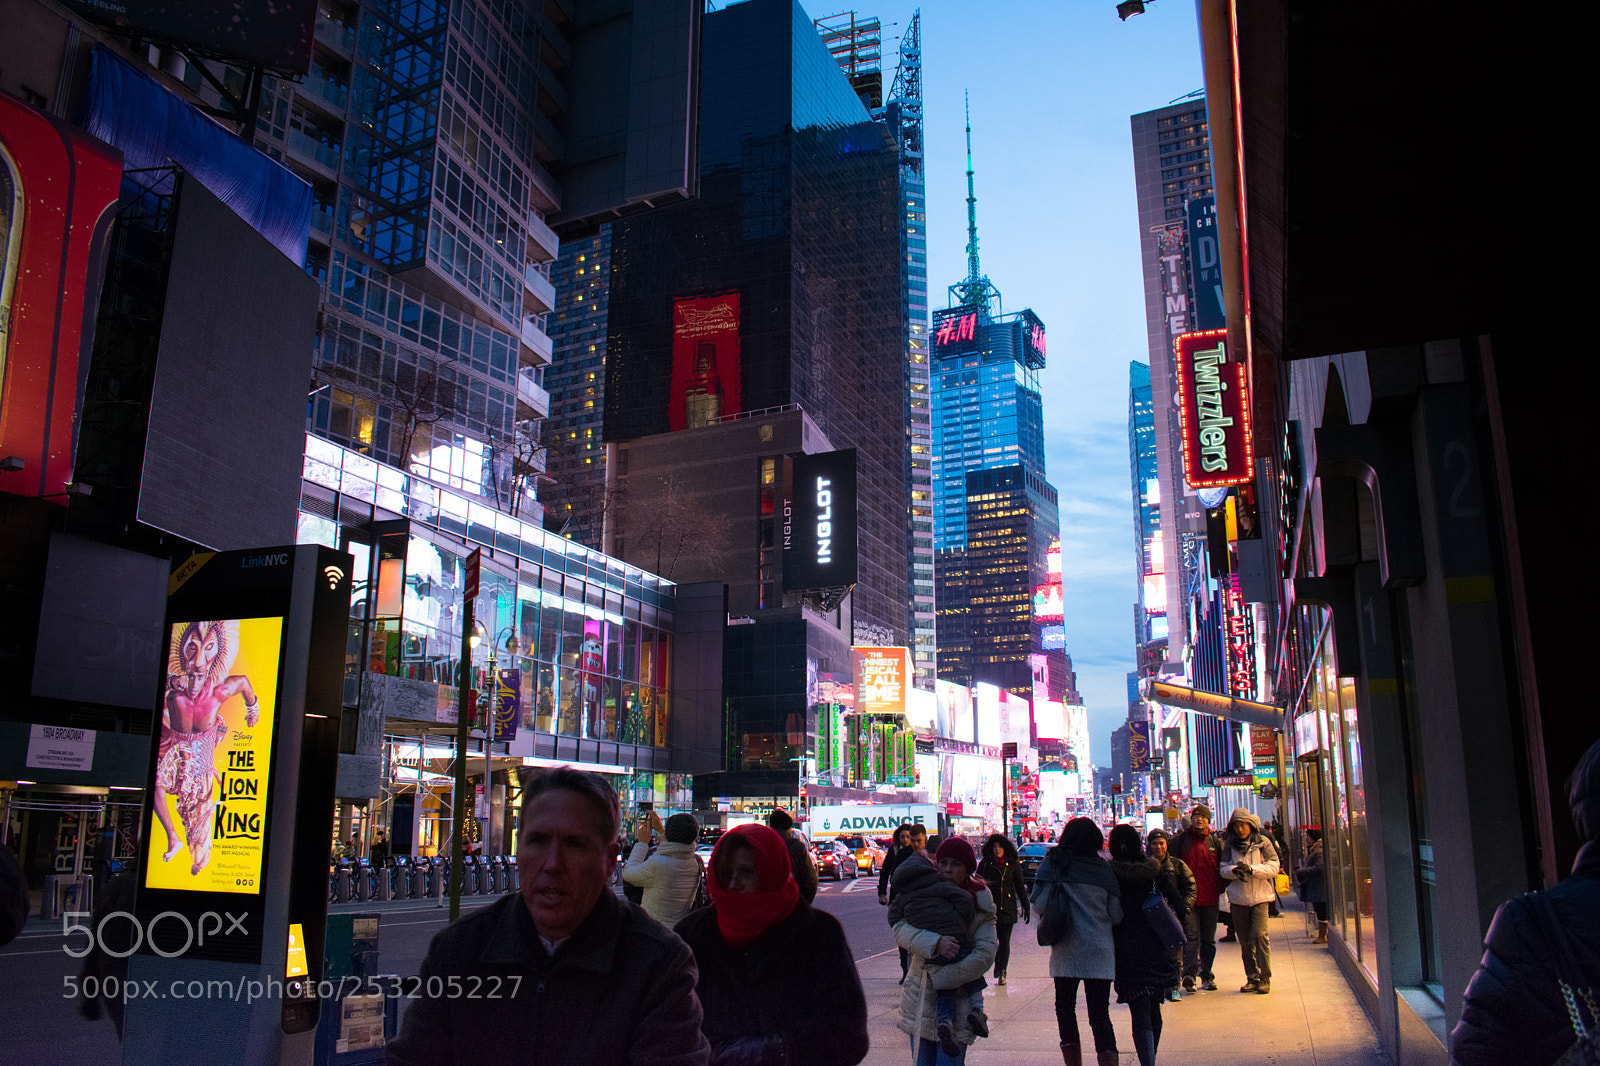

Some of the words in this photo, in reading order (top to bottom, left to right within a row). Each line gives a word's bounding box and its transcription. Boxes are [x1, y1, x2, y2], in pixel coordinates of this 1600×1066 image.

[936, 313, 977, 346] H&M
[1191, 340, 1233, 474] Twizzlers
[1442, 440, 1481, 519] 2
[783, 499, 792, 550] INGLOT
[816, 476, 832, 564] INGLOT
[241, 553, 288, 568] LinkNYC
[176, 561, 197, 581] BETA
[874, 674, 900, 686] ALL
[1174, 692, 1211, 706] CROWNE
[1213, 701, 1240, 712] PLAZA
[55, 728, 86, 741] BROADWAY
[232, 731, 253, 742] Disney
[228, 751, 255, 768] THE
[1254, 766, 1275, 775] SHOP
[220, 772, 259, 802] LION
[213, 804, 260, 840] KING
[839, 815, 924, 830] ADVANCE
